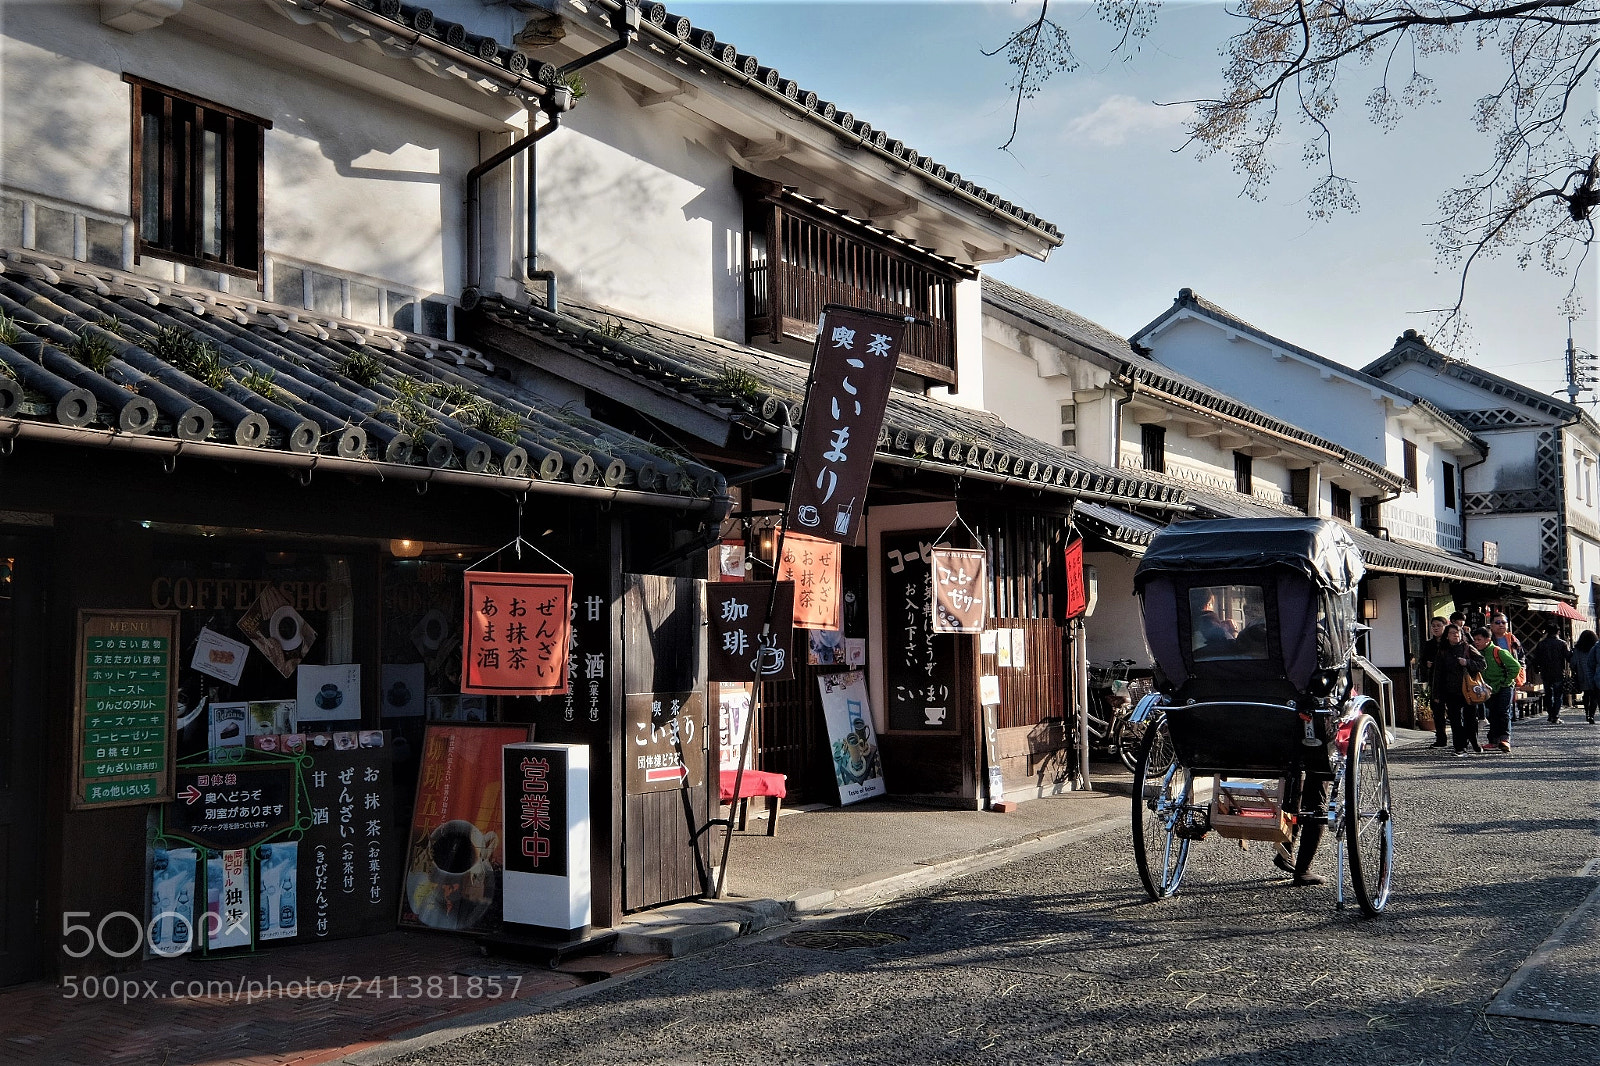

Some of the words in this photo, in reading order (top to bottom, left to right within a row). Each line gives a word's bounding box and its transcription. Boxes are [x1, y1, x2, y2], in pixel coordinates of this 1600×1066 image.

[831, 326, 893, 358] 喫茶
[816, 357, 865, 505] こいまり
[800, 549, 816, 608] お抹茶
[818, 551, 833, 616] ぜんざい
[938, 566, 972, 585] コーヒー
[947, 588, 982, 612] ゼリー
[109, 621, 150, 632] MENU
[477, 595, 500, 670] あま酒
[505, 597, 529, 670] お抹茶
[720, 597, 750, 657] 珈琲
[904, 583, 919, 667] お入り下さい
[94, 639, 161, 649] つめたい飲物
[535, 596, 558, 678] ぜんざい
[93, 654, 161, 665] あたたかい飲物
[92, 670, 161, 680] ホットケーキ
[107, 685, 145, 695] トースト
[896, 684, 949, 703] こいまり
[96, 700, 157, 711] りんごのタルト
[651, 699, 680, 717] 喫茶
[90, 716, 160, 727] チーズケーキ
[635, 715, 695, 746] こいまり
[91, 731, 159, 743] コーヒーゼリー
[96, 747, 153, 758] 白桃ゼリー
[197, 774, 237, 787] 団体様
[91, 782, 151, 799] 其の他いろいろ
[204, 789, 262, 804] 奥へどうぞ
[204, 804, 284, 820] 別室があります
[519, 756, 551, 868] 営業中
[224, 855, 234, 888] 地ビール
[233, 850, 243, 876] 岡山の
[225, 888, 243, 927] 独歩
